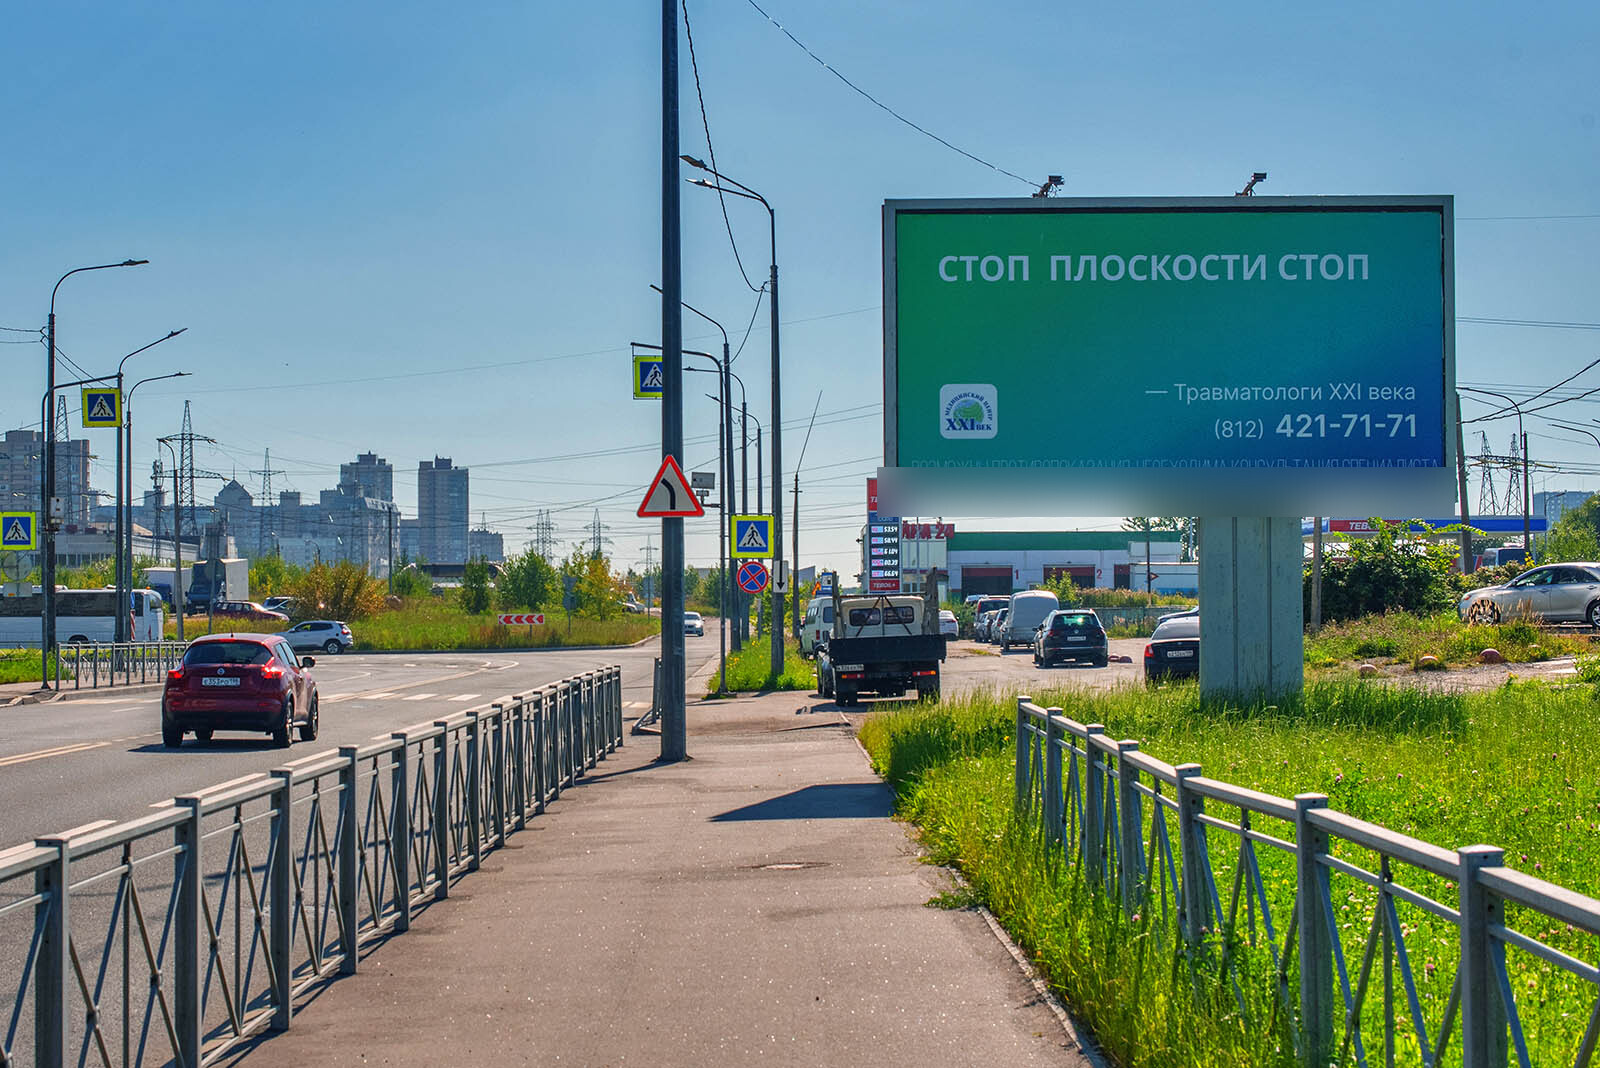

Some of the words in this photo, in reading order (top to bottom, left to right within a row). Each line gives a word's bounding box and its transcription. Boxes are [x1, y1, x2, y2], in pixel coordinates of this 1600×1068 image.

[938, 255, 1030, 282] СТОП
[1050, 254, 1267, 281] ПЛОСКОСТИ
[1278, 253, 1369, 281] СТОП
[1174, 383, 1322, 404] Травматологи
[1329, 383, 1361, 400] XXI
[1369, 386, 1416, 400] века
[976, 423, 992, 431] ВЕК
[1214, 418, 1264, 440] (812)
[1275, 413, 1417, 438] 421-71-71
[1096, 568, 1103, 580] 2
